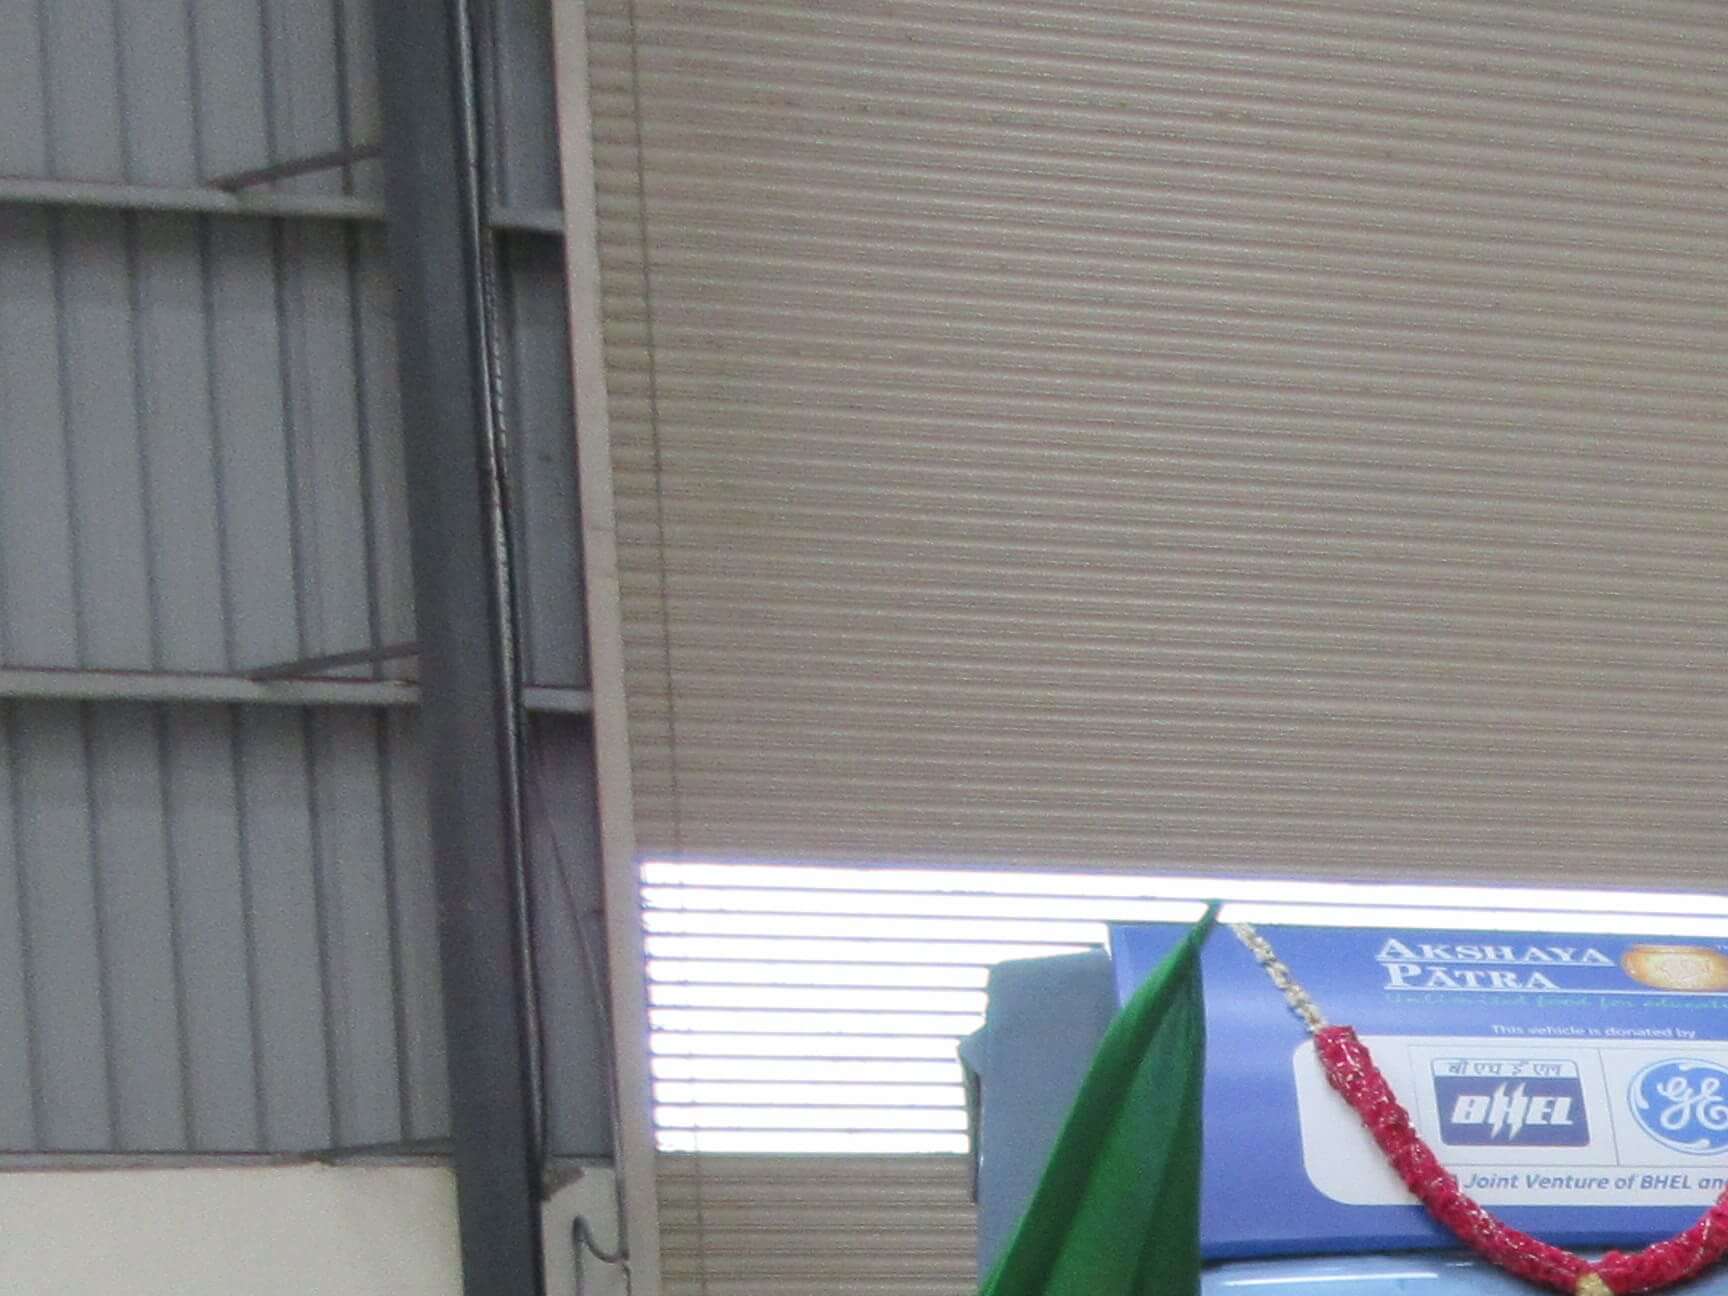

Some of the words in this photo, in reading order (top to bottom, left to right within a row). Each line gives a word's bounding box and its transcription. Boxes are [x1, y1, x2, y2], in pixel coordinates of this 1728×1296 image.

[1376, 937, 1615, 966] AKSHAYA
[1492, 1024, 1523, 1035] This
[1527, 1025, 1585, 1036] vehicle
[1589, 1027, 1600, 1037] is
[1604, 1027, 1672, 1038] donated
[1676, 1027, 1697, 1040] by
[1451, 1081, 1574, 1141] BHEL
[1464, 1173, 1519, 1190] Joint
[1525, 1173, 1610, 1190] Venture
[1614, 1173, 1638, 1190] of
[1640, 1174, 1692, 1190] BHEL
